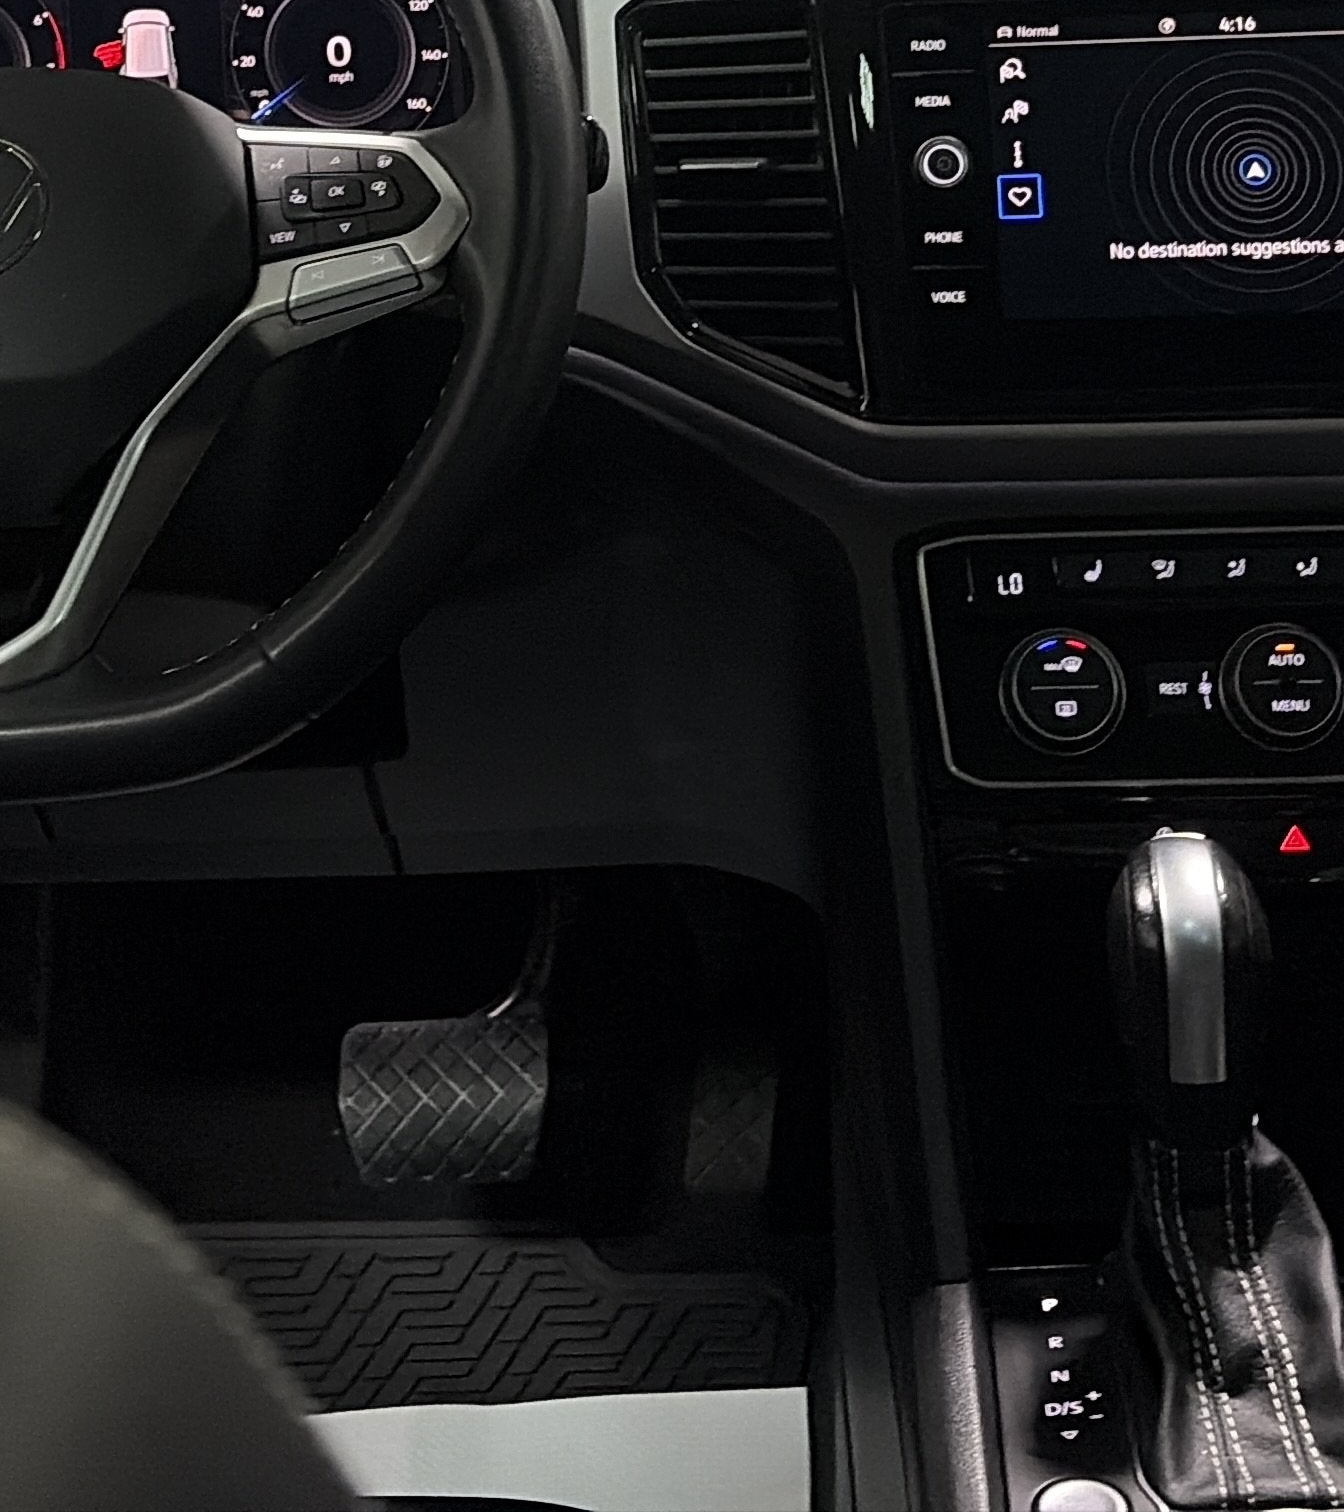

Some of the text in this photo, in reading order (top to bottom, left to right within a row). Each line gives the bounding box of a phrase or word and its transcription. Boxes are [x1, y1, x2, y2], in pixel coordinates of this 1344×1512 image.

[246, 5, 264, 19] 40
[32, 14, 43, 27] 6
[1218, 15, 1257, 33] 4:16
[1016, 24, 1059, 38] Normal
[326, 35, 352, 68] 0
[910, 39, 947, 52] RADIO
[239, 55, 256, 68] 20
[420, 49, 442, 61] 140
[328, 71, 354, 85] mph
[406, 97, 427, 111] 160
[914, 94, 951, 108] MEDIA
[327, 184, 345, 198] OK
[269, 230, 296, 244] VIEW
[923, 230, 964, 244] PHONE
[1109, 242, 1136, 260] No
[1137, 240, 1228, 260] destination
[1231, 237, 1331, 260] suggestions
[930, 290, 967, 304] VOICE
[1267, 653, 1306, 667] AUTO
[1158, 682, 1189, 695] REST
[1271, 698, 1311, 712] MENU
[1041, 1296, 1059, 1312] P
[1047, 1335, 1064, 1349] R
[1050, 1369, 1071, 1383] N
[1044, 1400, 1085, 1417] D/S
